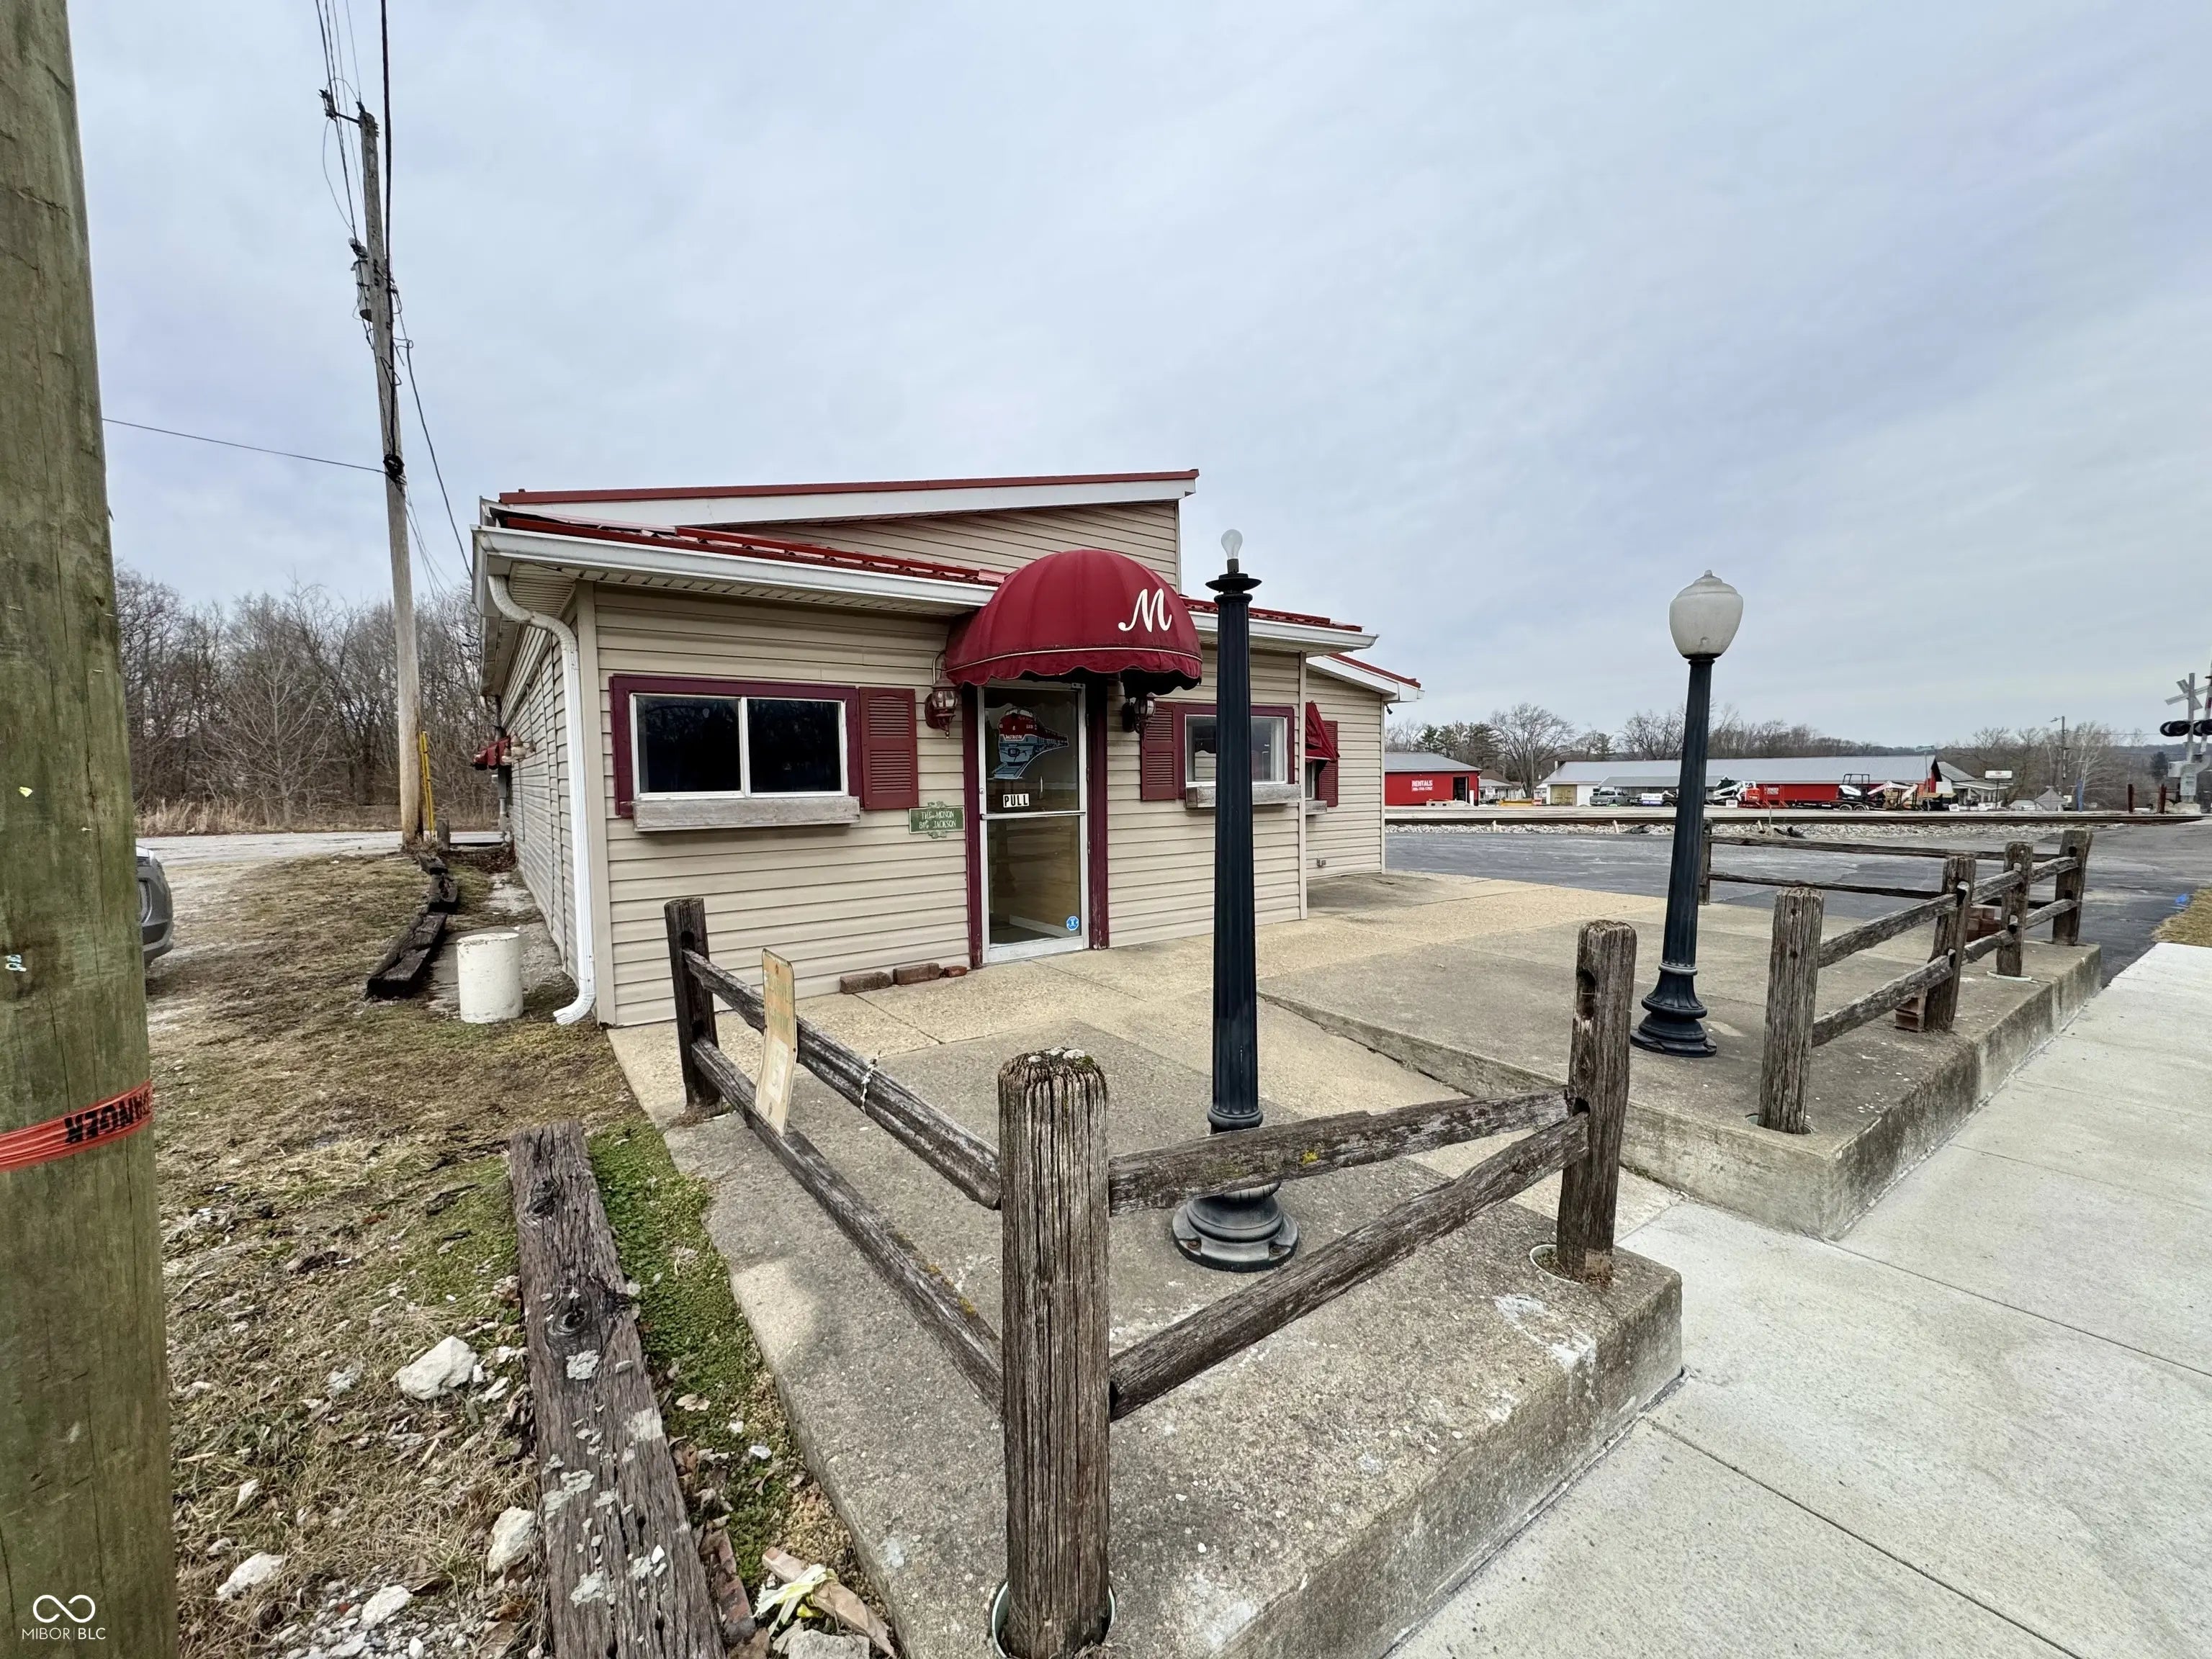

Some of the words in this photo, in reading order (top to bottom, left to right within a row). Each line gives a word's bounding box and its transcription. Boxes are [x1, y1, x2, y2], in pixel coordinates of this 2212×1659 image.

[1118, 588, 1172, 633] M
[1004, 795, 1028, 806] PULL
[936, 811, 954, 819] MONON
